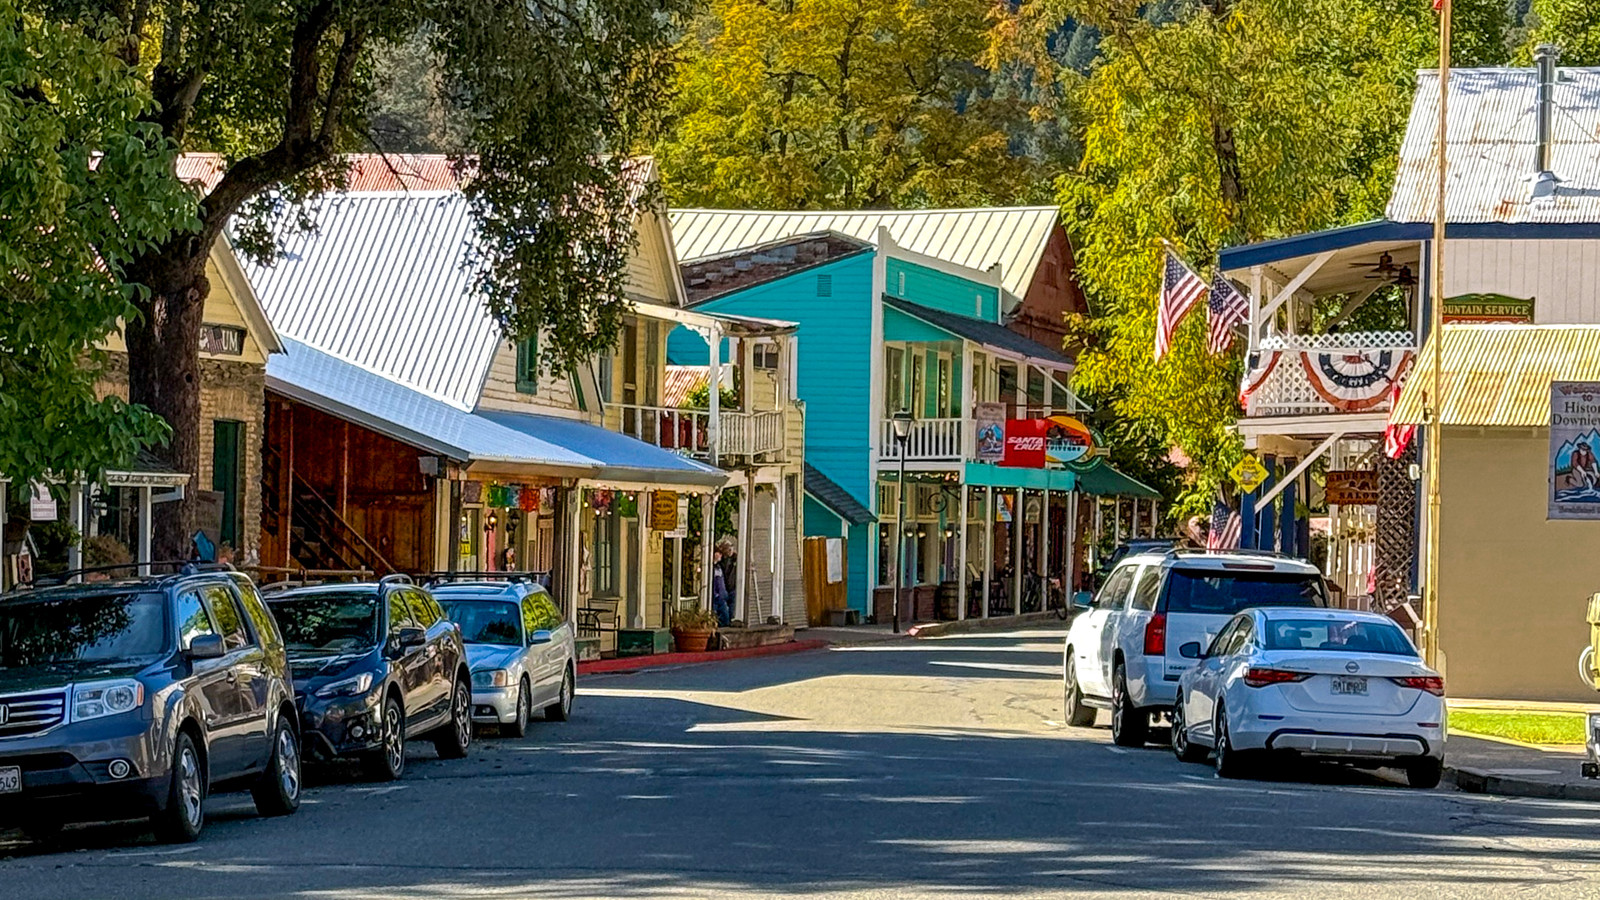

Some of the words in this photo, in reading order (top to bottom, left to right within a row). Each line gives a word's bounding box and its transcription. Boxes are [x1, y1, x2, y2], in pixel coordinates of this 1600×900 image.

[1442, 305, 1482, 315] OUNTAIN
[1484, 305, 1529, 315] SERVICE
[1558, 384, 1600, 396] Welco
[1582, 394, 1593, 402] to
[1007, 436, 1044, 444] SANTA
[1014, 443, 1043, 451] CRUZ
[1339, 491, 1379, 499] SALOO
[0, 776, 18, 789] 549
